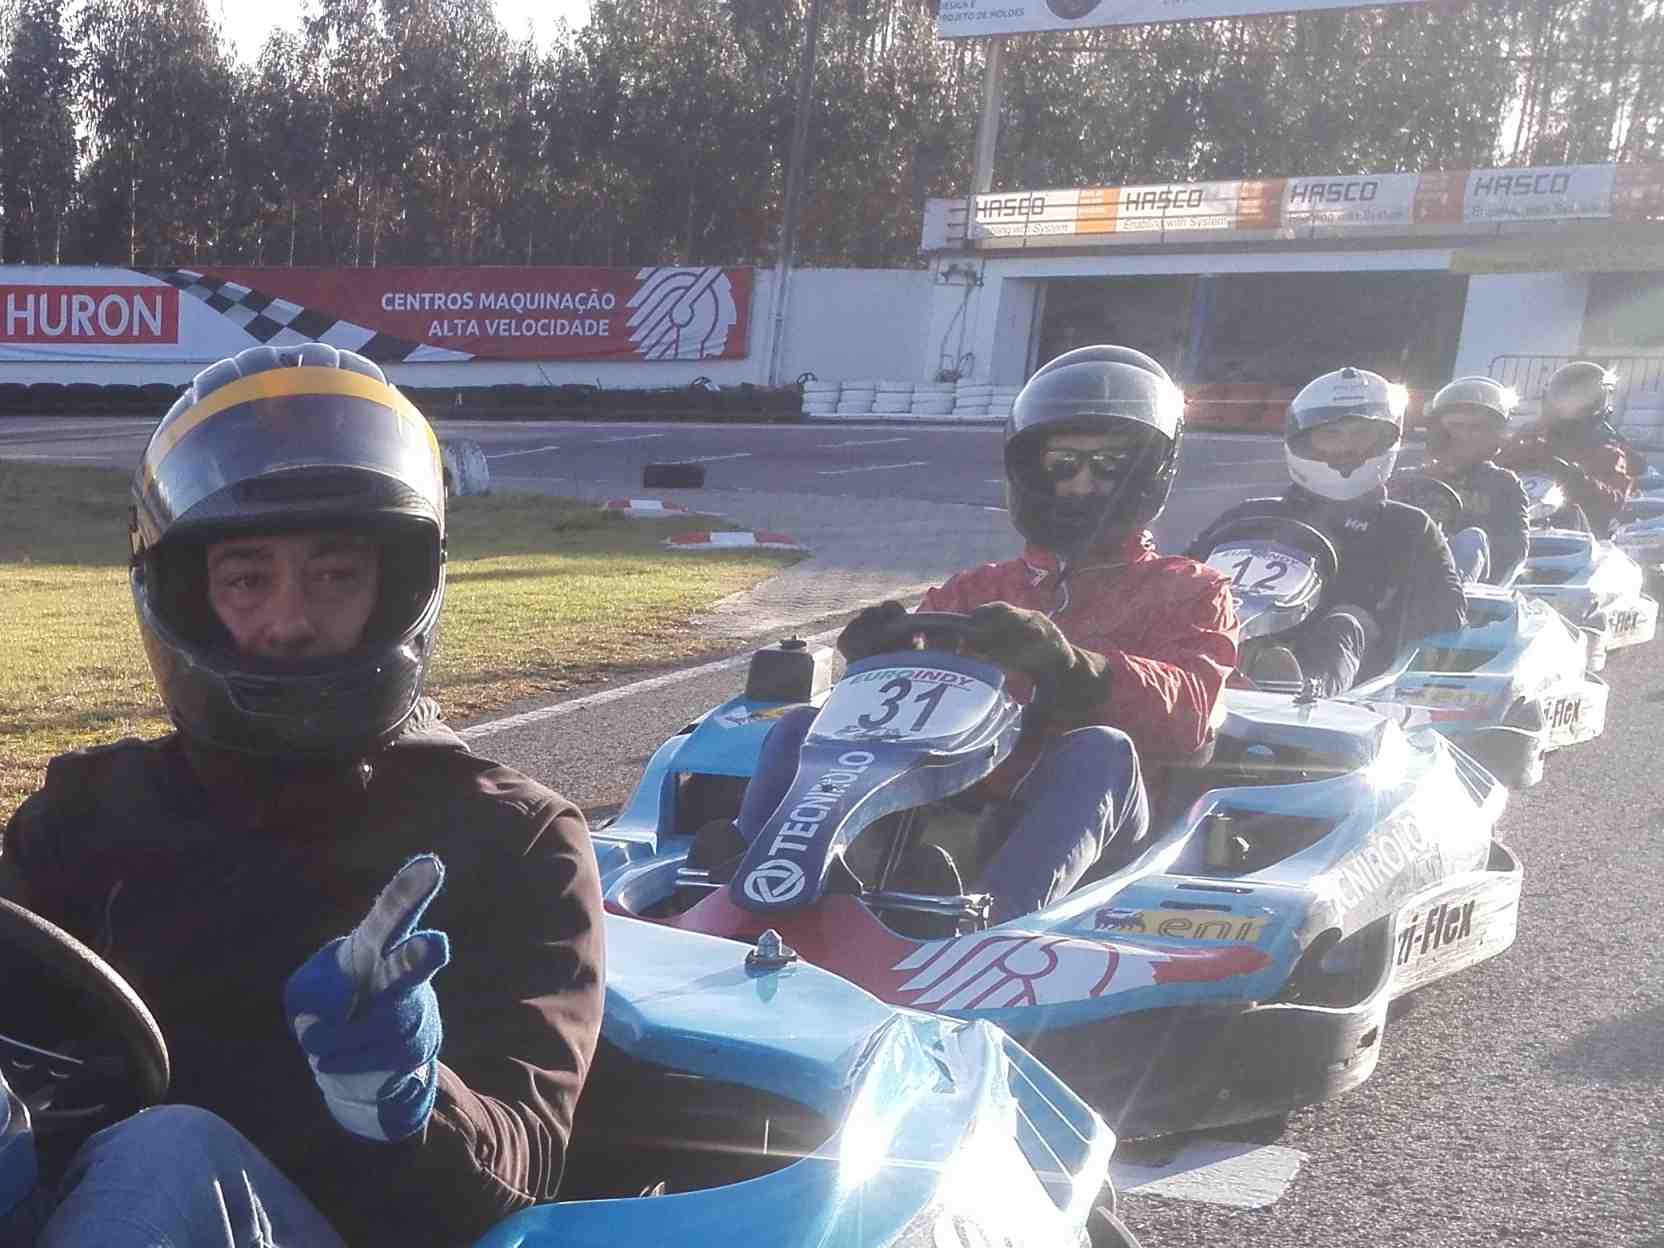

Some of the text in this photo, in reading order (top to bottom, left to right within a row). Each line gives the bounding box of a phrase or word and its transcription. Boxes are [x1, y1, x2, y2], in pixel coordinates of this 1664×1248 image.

[1290, 181, 1379, 203] HASCO
[1474, 173, 1570, 197] HASCO
[975, 197, 1045, 219] HASCO
[1125, 190, 1203, 212] HASCO
[382, 288, 616, 314] CENTROS MAQUINAÇÃO
[6, 293, 163, 337] HURON
[428, 319, 609, 336] ALTA VELOCIDADE
[1231, 556, 1288, 594] 12
[857, 677, 949, 733] 31
[768, 751, 875, 857] TECNIROLO
[1157, 914, 1262, 942] eni
